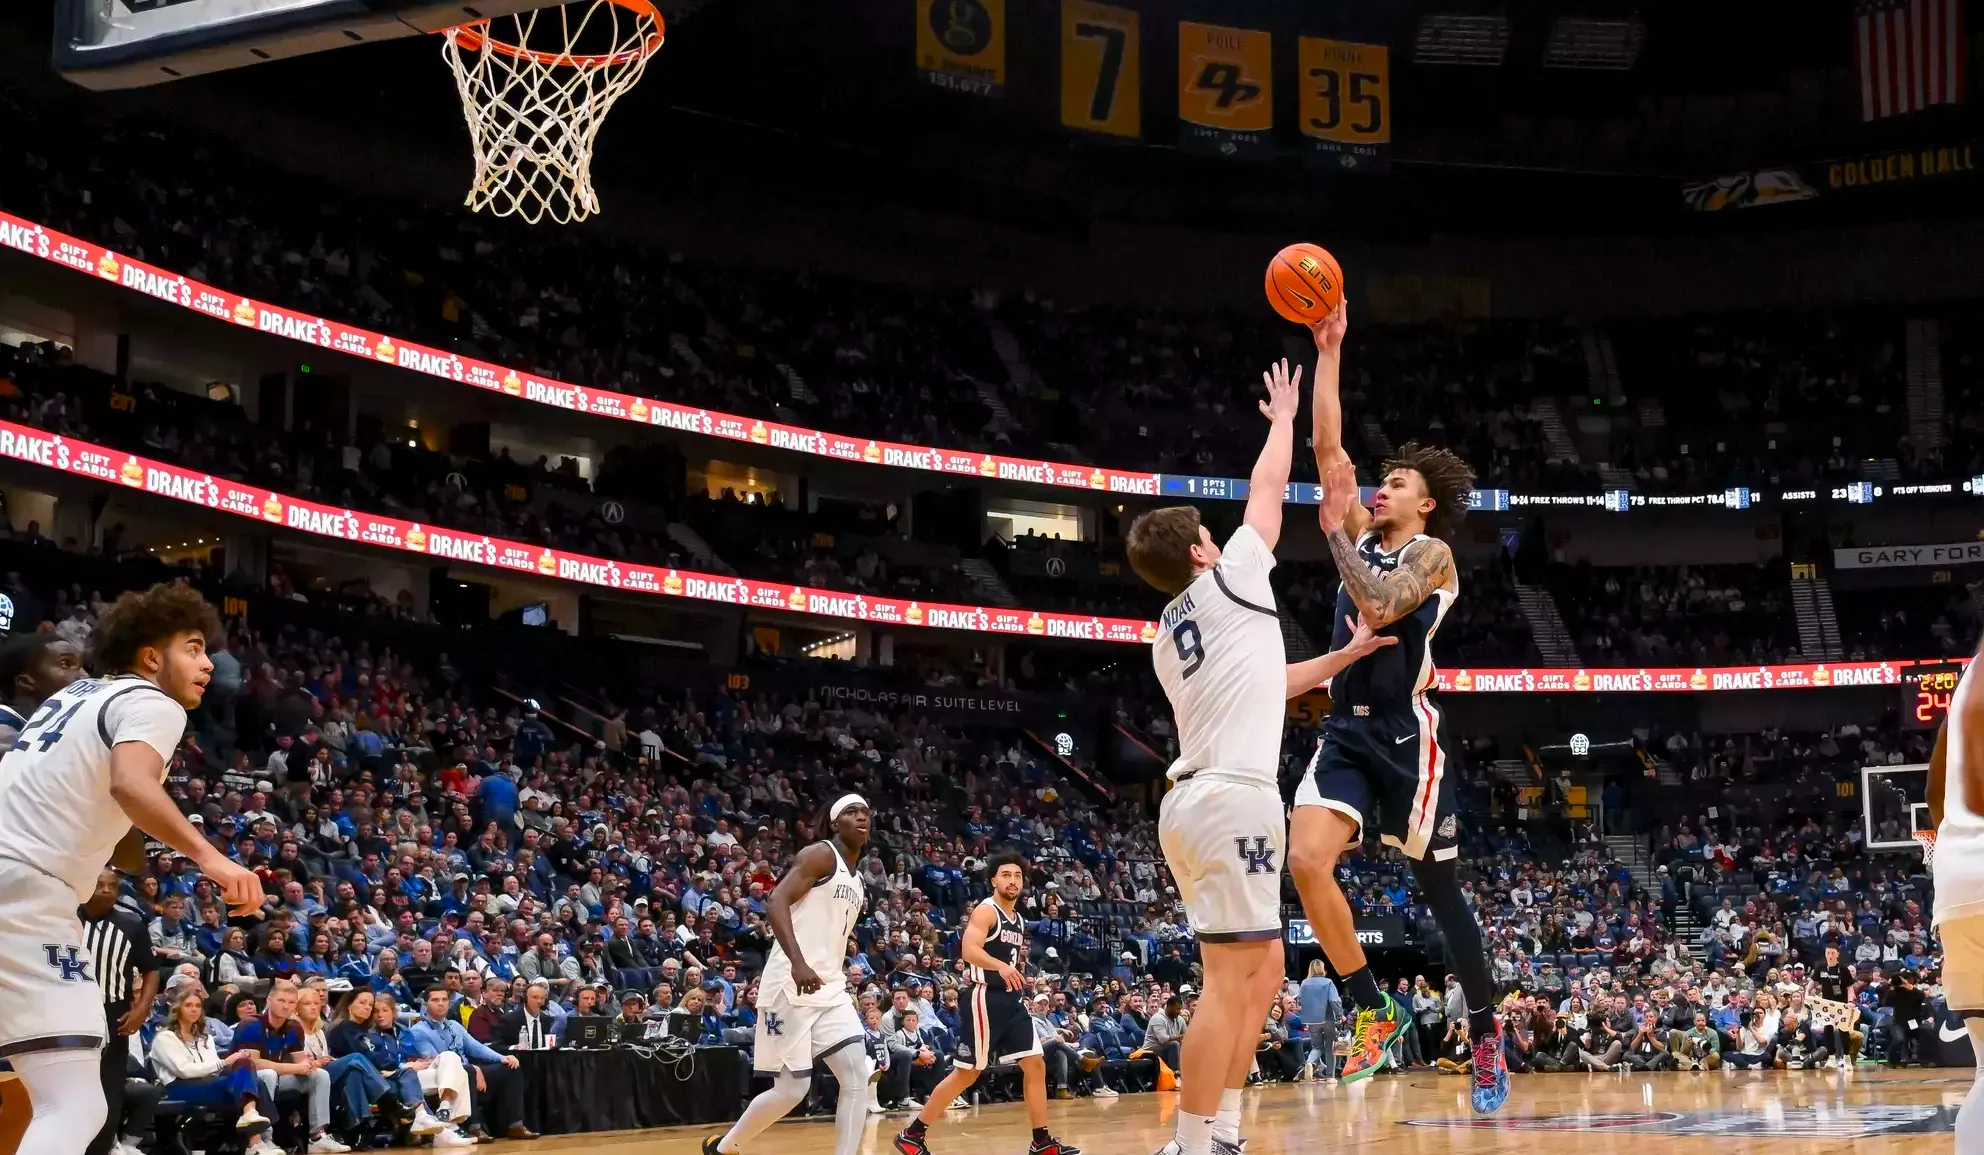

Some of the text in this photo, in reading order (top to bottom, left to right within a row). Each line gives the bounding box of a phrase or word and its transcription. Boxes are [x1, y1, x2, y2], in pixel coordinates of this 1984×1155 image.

[1075, 23, 1126, 120] 7
[1308, 67, 1383, 134] 35
[0, 220, 50, 257] AKE'S
[60, 242, 89, 261] GIFT
[53, 249, 95, 272] CARDS
[1299, 256, 1332, 293] ELITE
[123, 263, 192, 306] DRAKE'S
[201, 291, 226, 308] GIFT
[194, 300, 231, 319] CARDS
[260, 309, 331, 347] DRAKE'S
[340, 331, 367, 345] GIFT
[334, 339, 372, 356] CARDS
[399, 346, 463, 381] DRAKE'S
[472, 366, 496, 379] GIFT
[466, 373, 500, 390] CARDS
[526, 380, 588, 411] DRAKE'S
[597, 396, 621, 408] GIFT
[590, 403, 626, 417] CARDS
[651, 406, 712, 434] DRAKE'S
[720, 419, 743, 431] GIFT
[714, 427, 748, 440] CARDS
[0, 430, 70, 471] RAKE'S
[771, 430, 827, 456] DRAKE'S
[834, 440, 856, 451] GIFT
[81, 451, 110, 465] GIFT
[829, 447, 861, 460] CARDS
[884, 448, 942, 471] DRAKE'S
[950, 456, 972, 466] GIFT
[73, 460, 117, 480] CARDS
[945, 462, 977, 474] CARDS
[1000, 462, 1055, 484] DRAKE'S
[1062, 470, 1082, 479] GIFT
[147, 468, 219, 508] DRAKE'S
[1056, 477, 1087, 487] CARDS
[1188, 478, 1195, 493] 1
[1203, 479, 1225, 489] 8 PTS
[1892, 485, 1905, 495] PTS
[1906, 485, 1918, 494] OFF
[1919, 483, 1952, 493] TURNOVER
[228, 489, 254, 503] GIFT
[1210, 488, 1225, 497] FLS
[1314, 486, 1324, 500] 3
[1530, 496, 1550, 505] FREE
[1552, 496, 1584, 505] THROWS
[1751, 492, 1761, 502] 11
[1782, 490, 1816, 500] ASSISTS
[1832, 488, 1847, 499] 23
[221, 498, 260, 516] CARDS
[1471, 499, 1481, 507] LS
[1630, 496, 1645, 506] 75
[1648, 496, 1665, 505] FREE
[1667, 496, 1689, 505] THROW
[1691, 496, 1704, 504] PCT
[289, 504, 360, 540] DRAKE'S
[369, 522, 395, 536] GIFT
[362, 530, 401, 546] CARDS
[430, 536, 497, 566] DRAKE'S
[505, 547, 529, 560] GIFT
[1858, 549, 1921, 565] GARY
[499, 556, 534, 570] CARDS
[560, 561, 621, 588] DRAKE'S
[629, 571, 653, 583] GIFT
[623, 579, 659, 592] CARDS
[686, 579, 750, 604] DRAKE'S
[757, 588, 780, 599] GIFT
[751, 595, 785, 608] CARDS
[809, 595, 867, 620] DRAKE'S
[874, 604, 896, 615] GIFT
[870, 610, 901, 621] CARDS
[1163, 592, 1196, 630] NOAH
[928, 608, 988, 632] DRAKE'S
[991, 622, 1024, 633] CARDS
[996, 616, 1017, 625] GIFT
[1048, 618, 1103, 639] DRAKE'S
[1106, 632, 1138, 641] CARDS
[1112, 625, 1132, 633] GIFT
[1173, 619, 1205, 681] 9
[1475, 669, 1534, 692] DRAKE'S
[1543, 674, 1565, 682] GIFT
[1593, 669, 1652, 692] DRAKE'S
[1660, 674, 1681, 682] GIFT
[1713, 667, 1772, 690] DRAKE'S
[1781, 671, 1803, 680] GIFT
[1833, 662, 1894, 685] DRAKE'S
[1537, 682, 1569, 690] CARDS
[1655, 682, 1687, 690] CARDS
[1776, 677, 1808, 687] CARDS
[821, 684, 1022, 712] NICHOLAS AIR SUITE LEVEL
[1916, 692, 1951, 721] 24
[1233, 836, 1276, 875] UK
[842, 908, 849, 936] 1
[43, 943, 94, 981] UK
[764, 1012, 785, 1036] UK
